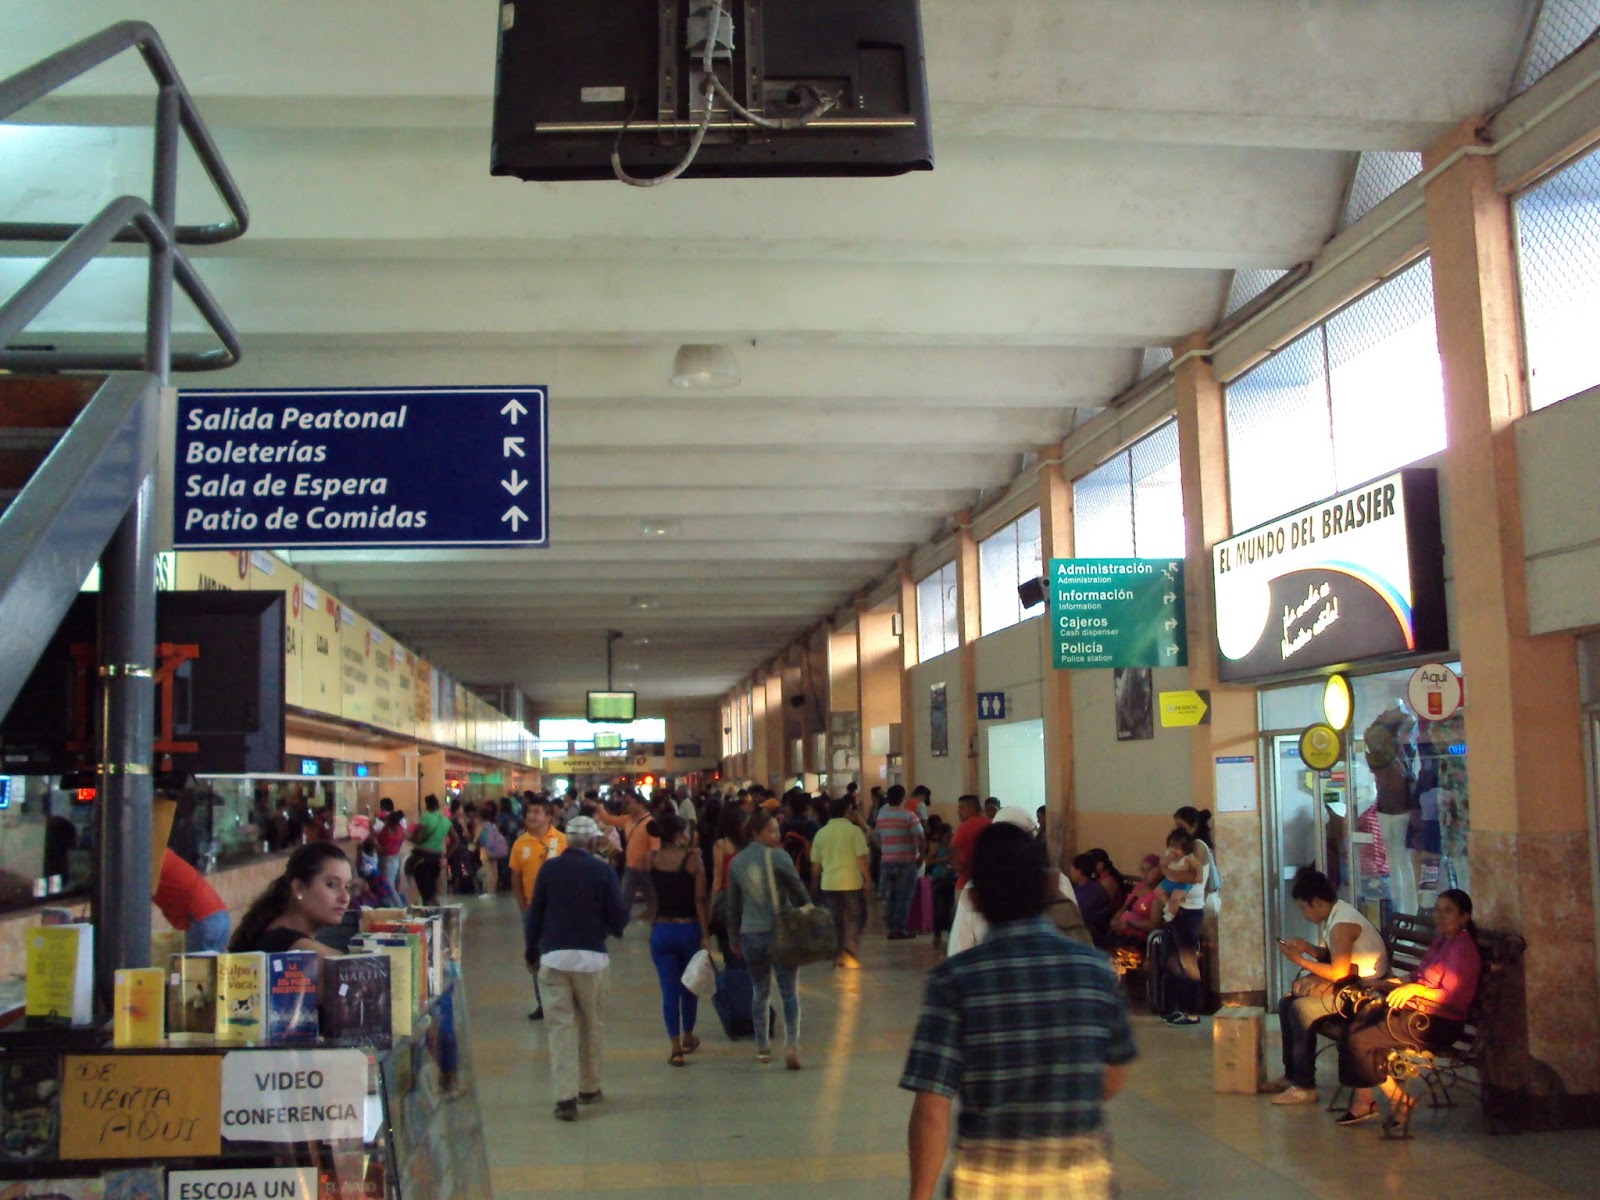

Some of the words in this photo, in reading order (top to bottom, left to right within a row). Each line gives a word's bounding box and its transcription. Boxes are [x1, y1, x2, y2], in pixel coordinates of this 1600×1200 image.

[186, 406, 274, 431] Salida
[280, 405, 407, 430] Peatonal
[186, 438, 327, 464] Boleterías
[185, 474, 246, 497] Sala
[253, 473, 287, 497] de
[293, 474, 388, 501] Espera
[185, 507, 258, 531] Patio
[265, 507, 299, 530] de
[306, 504, 427, 529] Comidas
[1220, 547, 1231, 574] EL
[1236, 527, 1285, 568] MUNDO
[1291, 515, 1315, 550] DEL
[1321, 483, 1395, 539] BRASIER
[1058, 562, 1152, 575] Administración
[1058, 589, 1134, 601] Información
[1060, 616, 1108, 629] Cajeros
[1060, 629, 1080, 637] Cash
[1081, 629, 1119, 637] dispenser
[1061, 642, 1103, 654] Policía
[1061, 655, 1085, 663] Police
[1087, 654, 1113, 662] station
[1420, 670, 1448, 684] Aquí
[338, 968, 388, 982] MARTIN
[76, 1062, 117, 1082] DE
[254, 1070, 324, 1092] VIDEO
[223, 1102, 357, 1127] CONFERENCIA
[180, 1181, 258, 1200] ESCOJA
[264, 1180, 296, 1199] UN
